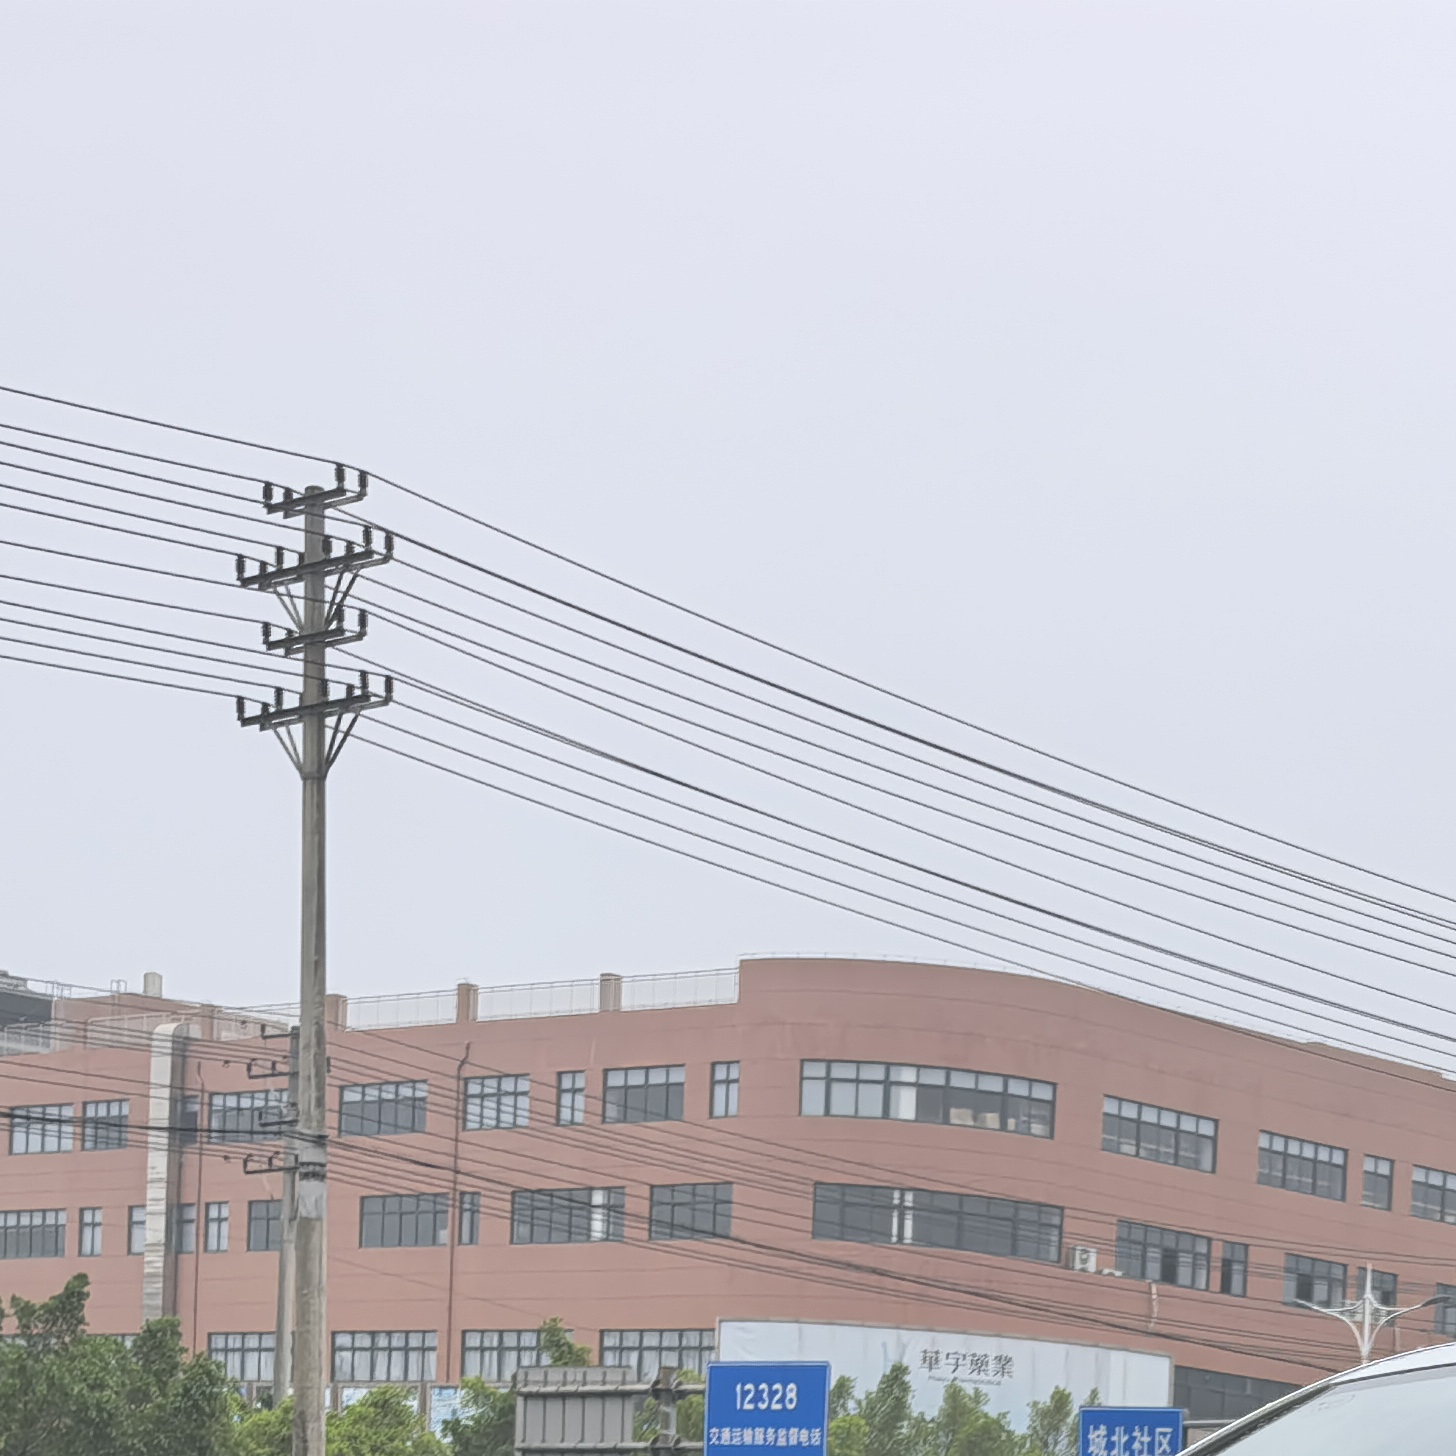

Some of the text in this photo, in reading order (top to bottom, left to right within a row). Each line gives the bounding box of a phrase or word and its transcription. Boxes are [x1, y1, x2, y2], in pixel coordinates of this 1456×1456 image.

[736, 1382, 797, 1410] 12328
[709, 1427, 822, 1446] 交通运输服务监督电话
